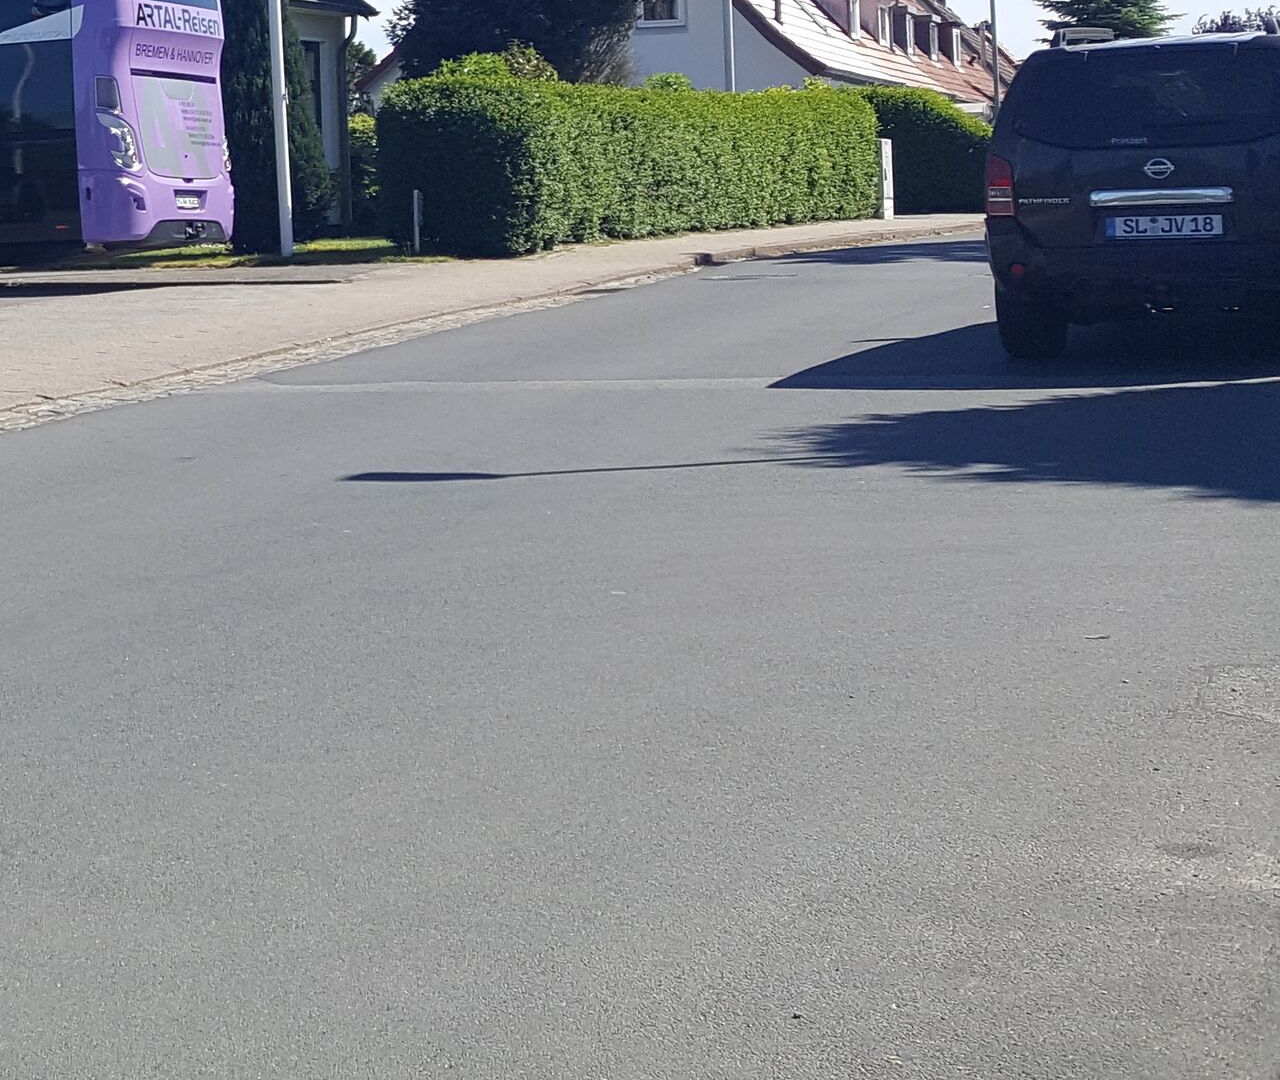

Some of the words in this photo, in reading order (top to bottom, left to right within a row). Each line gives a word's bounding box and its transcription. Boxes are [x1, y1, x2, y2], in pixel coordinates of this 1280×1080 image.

[136, 3, 220, 36] ARTAL-Reisen
[135, 43, 169, 60] BREMEN
[176, 48, 214, 65] HANNOVER
[1018, 197, 1071, 205] PATHFINDER
[1122, 219, 1148, 235] SL
[1160, 218, 1185, 234] JV
[1189, 216, 1215, 233] 18
